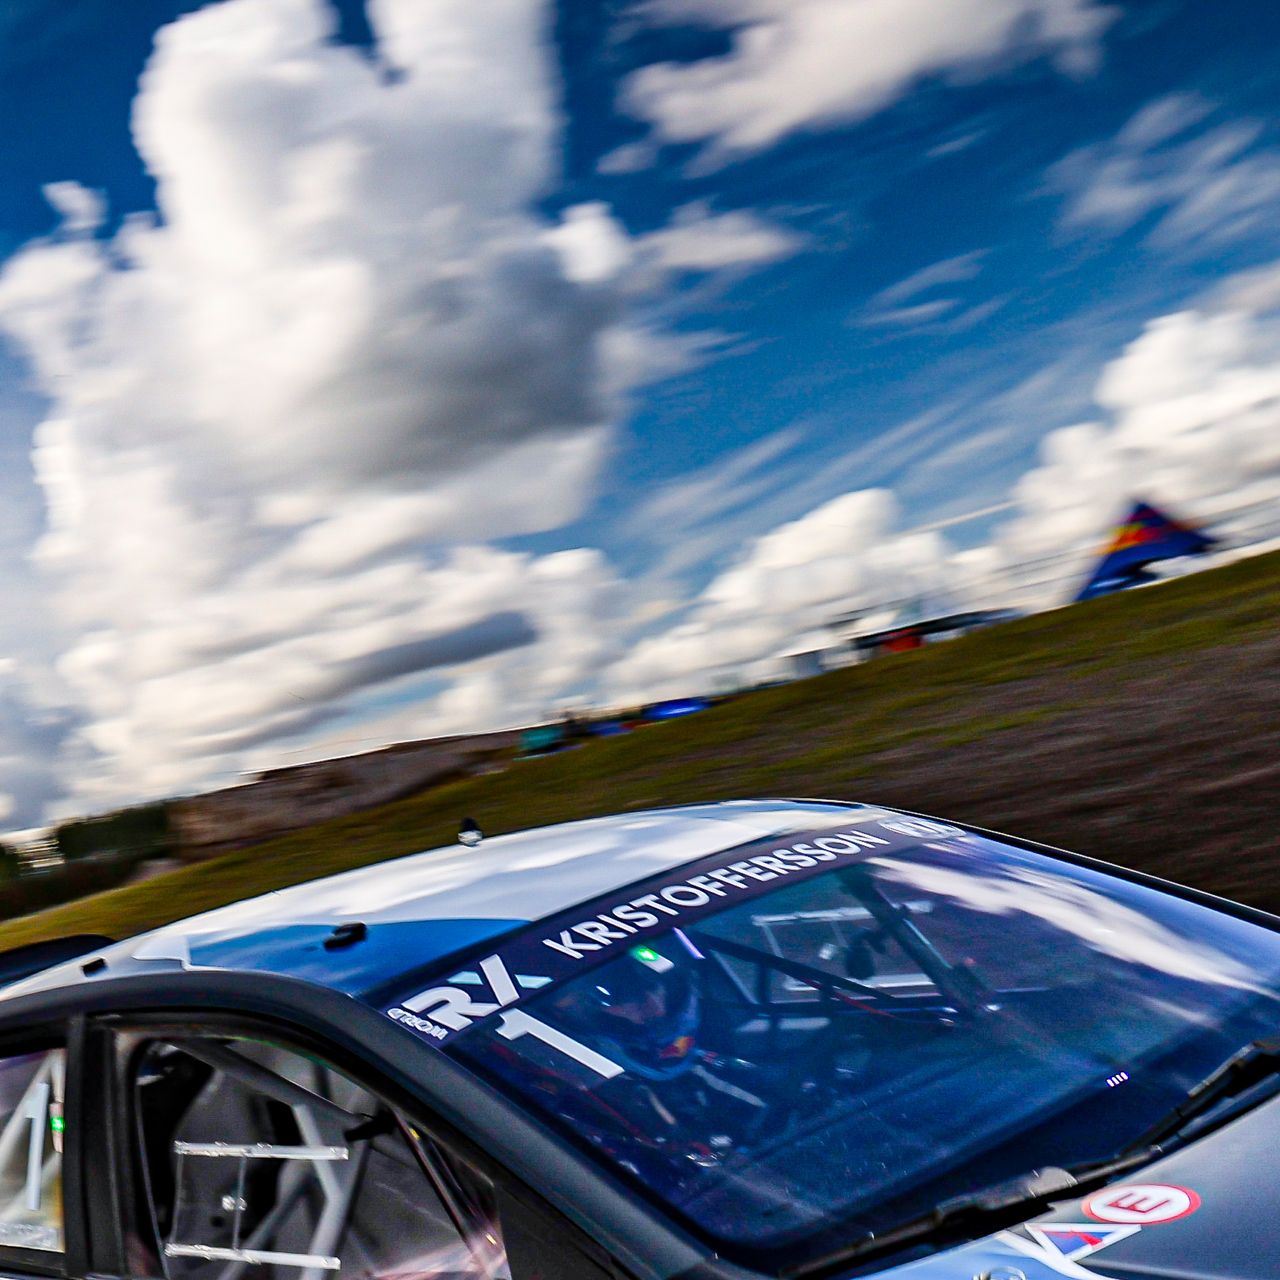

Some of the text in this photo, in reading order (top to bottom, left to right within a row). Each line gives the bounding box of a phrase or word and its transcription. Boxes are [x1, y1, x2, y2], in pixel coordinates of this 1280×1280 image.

[542, 830, 890, 960] KRISTOFFERSSON
[400, 953, 553, 1031] RX
[494, 1008, 625, 1080] 1
[22, 1082, 50, 1211] 1
